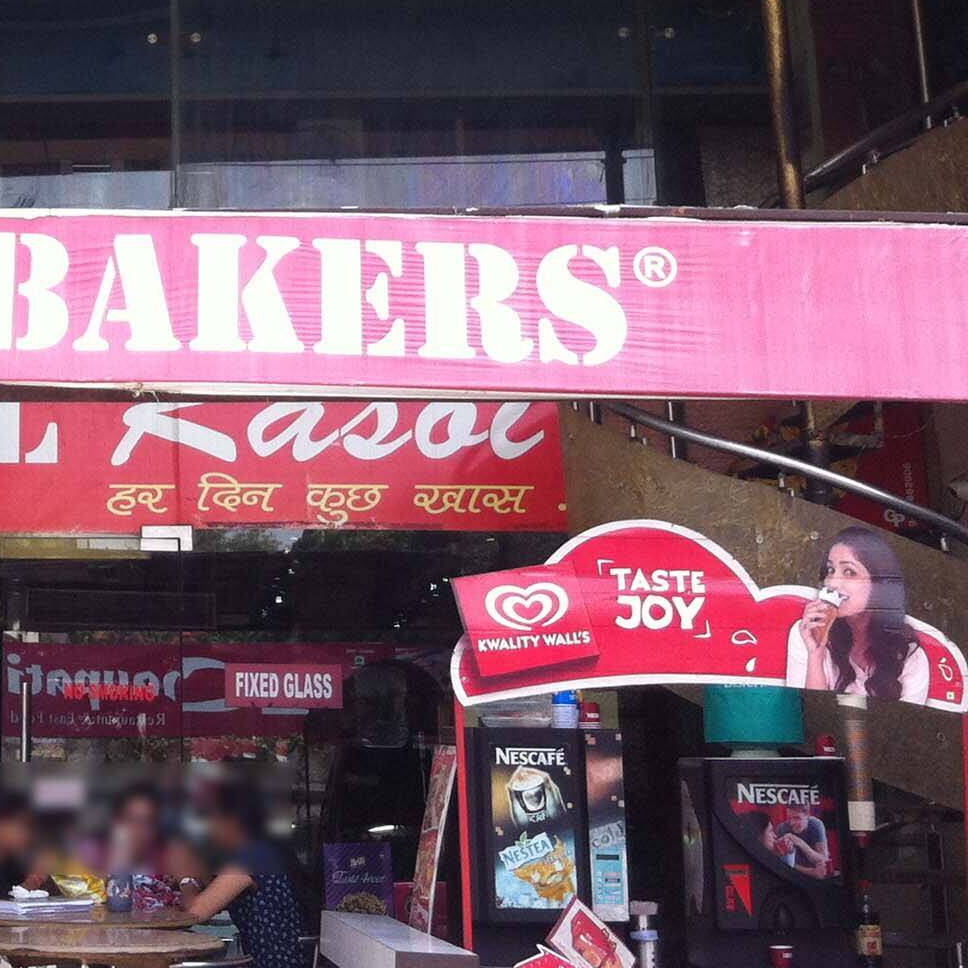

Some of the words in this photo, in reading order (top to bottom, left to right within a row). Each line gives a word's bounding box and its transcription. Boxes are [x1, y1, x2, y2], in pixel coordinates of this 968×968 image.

[106, 484, 176, 516] हर
[197, 472, 283, 513] दिन
[306, 484, 389, 526] कुछ
[413, 484, 535, 515] खास
[609, 567, 706, 594] TASTE
[615, 594, 705, 630] JOY
[477, 635, 540, 653] KWALITY
[543, 630, 592, 647] WALL'S
[235, 672, 279, 698] FIXED
[283, 673, 333, 699] GLASS
[495, 747, 566, 766] NESCAFÉ
[737, 783, 821, 805] NESCAFÉ
[504, 839, 551, 864] NESTEA
